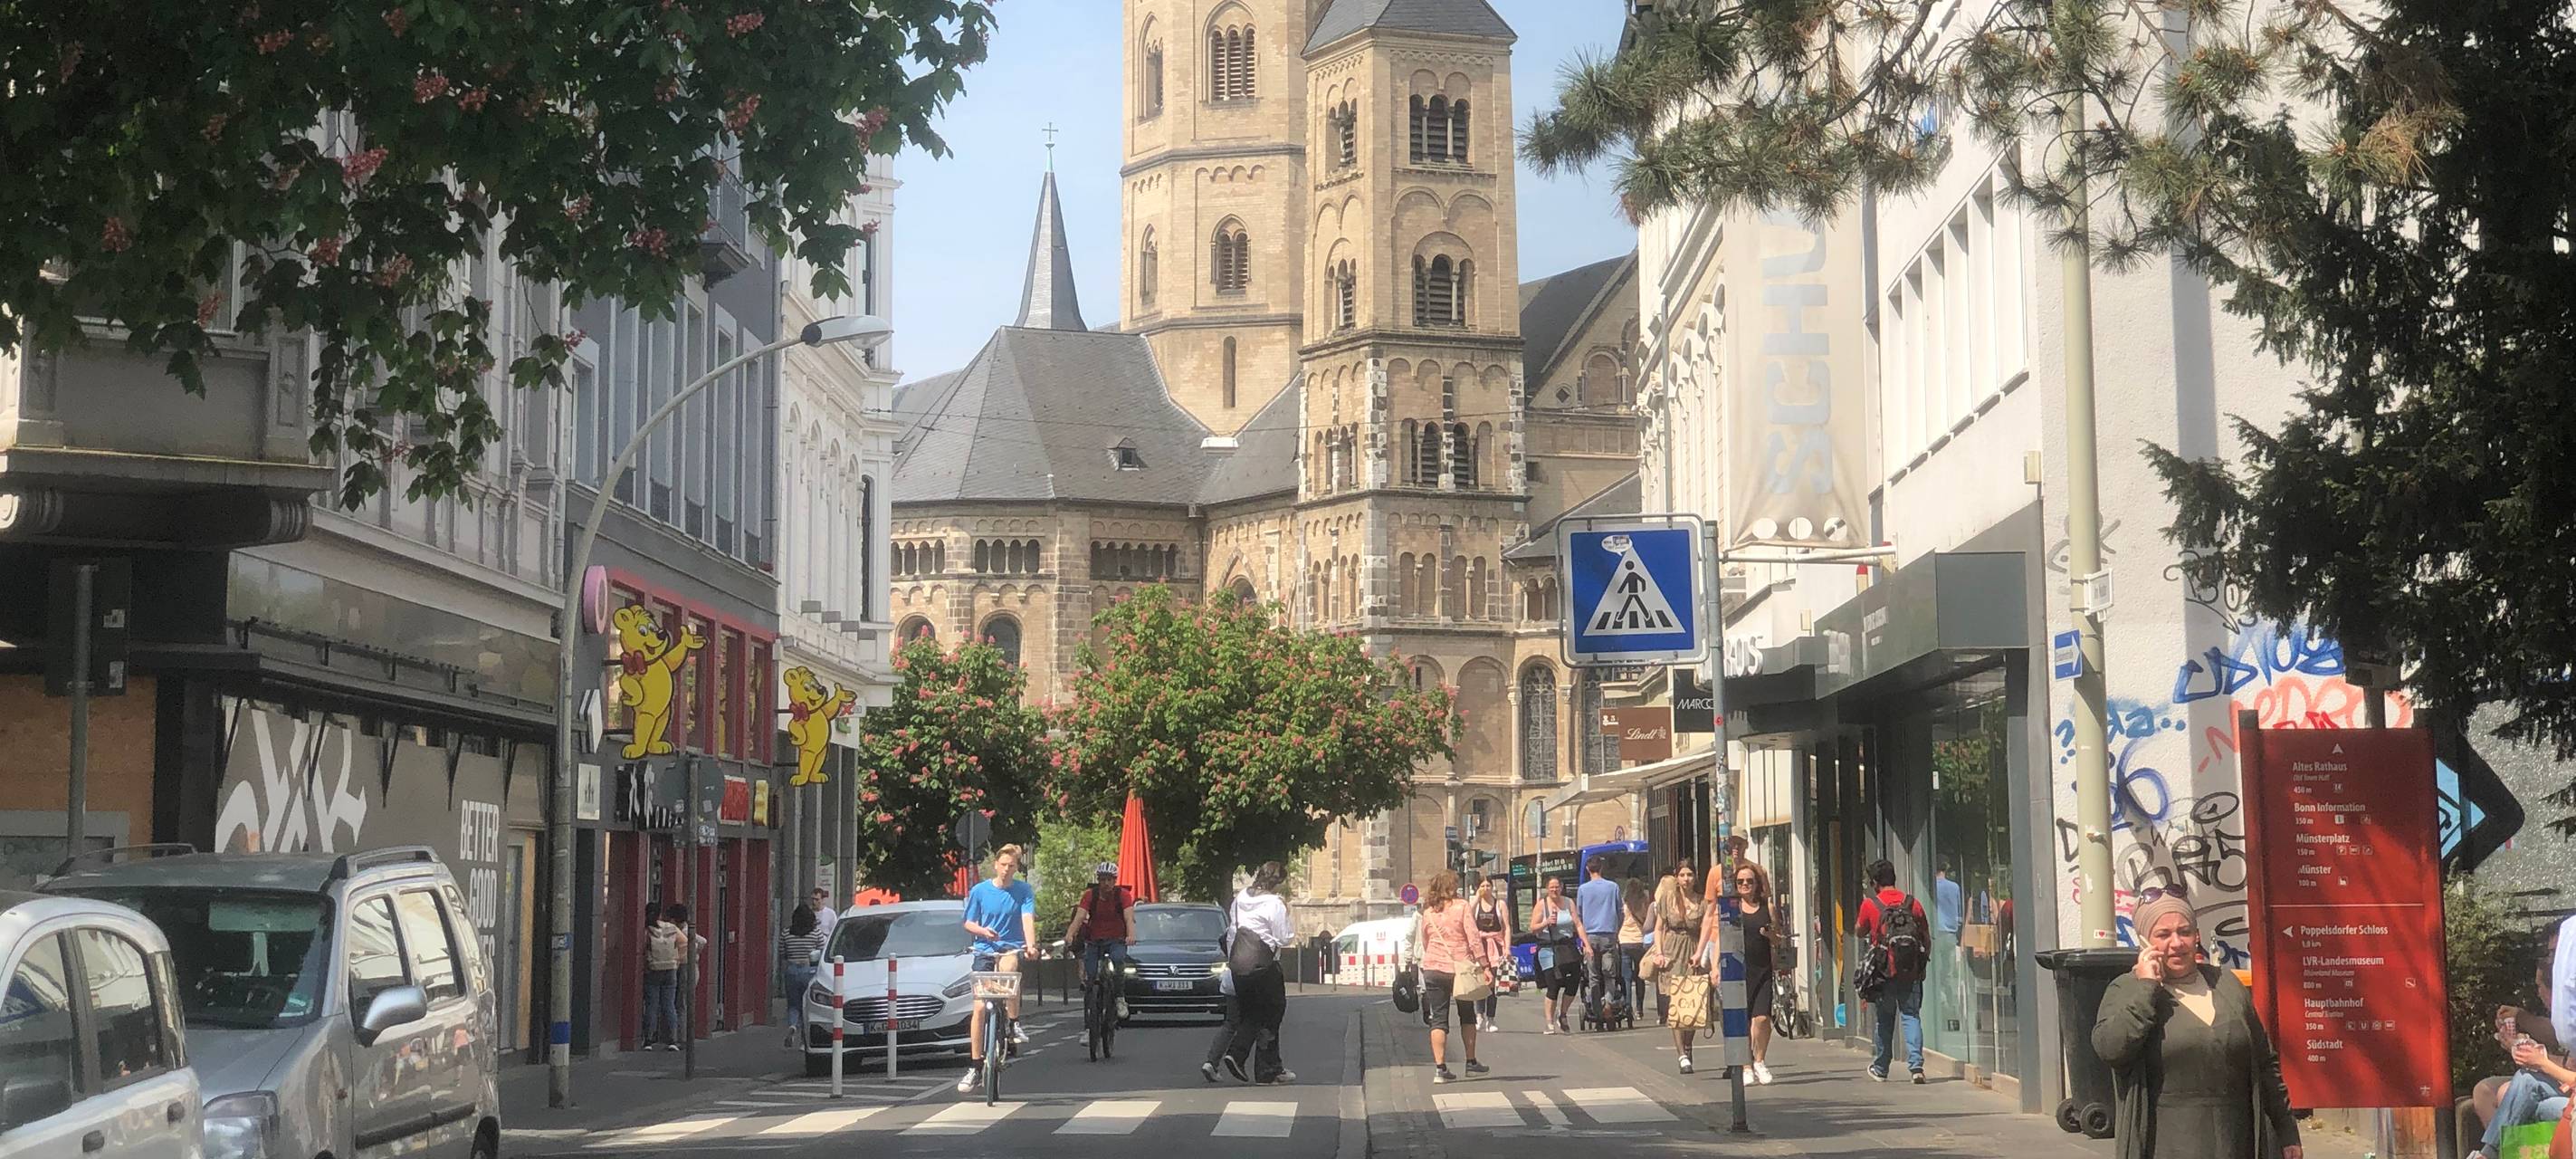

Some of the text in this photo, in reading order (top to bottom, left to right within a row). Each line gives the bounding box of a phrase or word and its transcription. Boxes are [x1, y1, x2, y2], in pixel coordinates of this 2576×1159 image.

[1624, 727, 1658, 740] Lindt
[2293, 761, 2347, 771] Altes Rathaus
[2295, 802, 2366, 812] Bonn Information
[460, 800, 500, 863] BETTER
[2296, 833, 2351, 844] Münsterplatz
[2298, 865, 2332, 875] Münster
[469, 867, 497, 928] GOOD
[2300, 924, 2389, 937] Poppelsdorfer Schloss
[2303, 956, 2384, 966] LVR-Landesmuseum
[2304, 998, 2364, 1009] Hauptbahnhof
[2306, 1039, 2343, 1049] Südstadt
